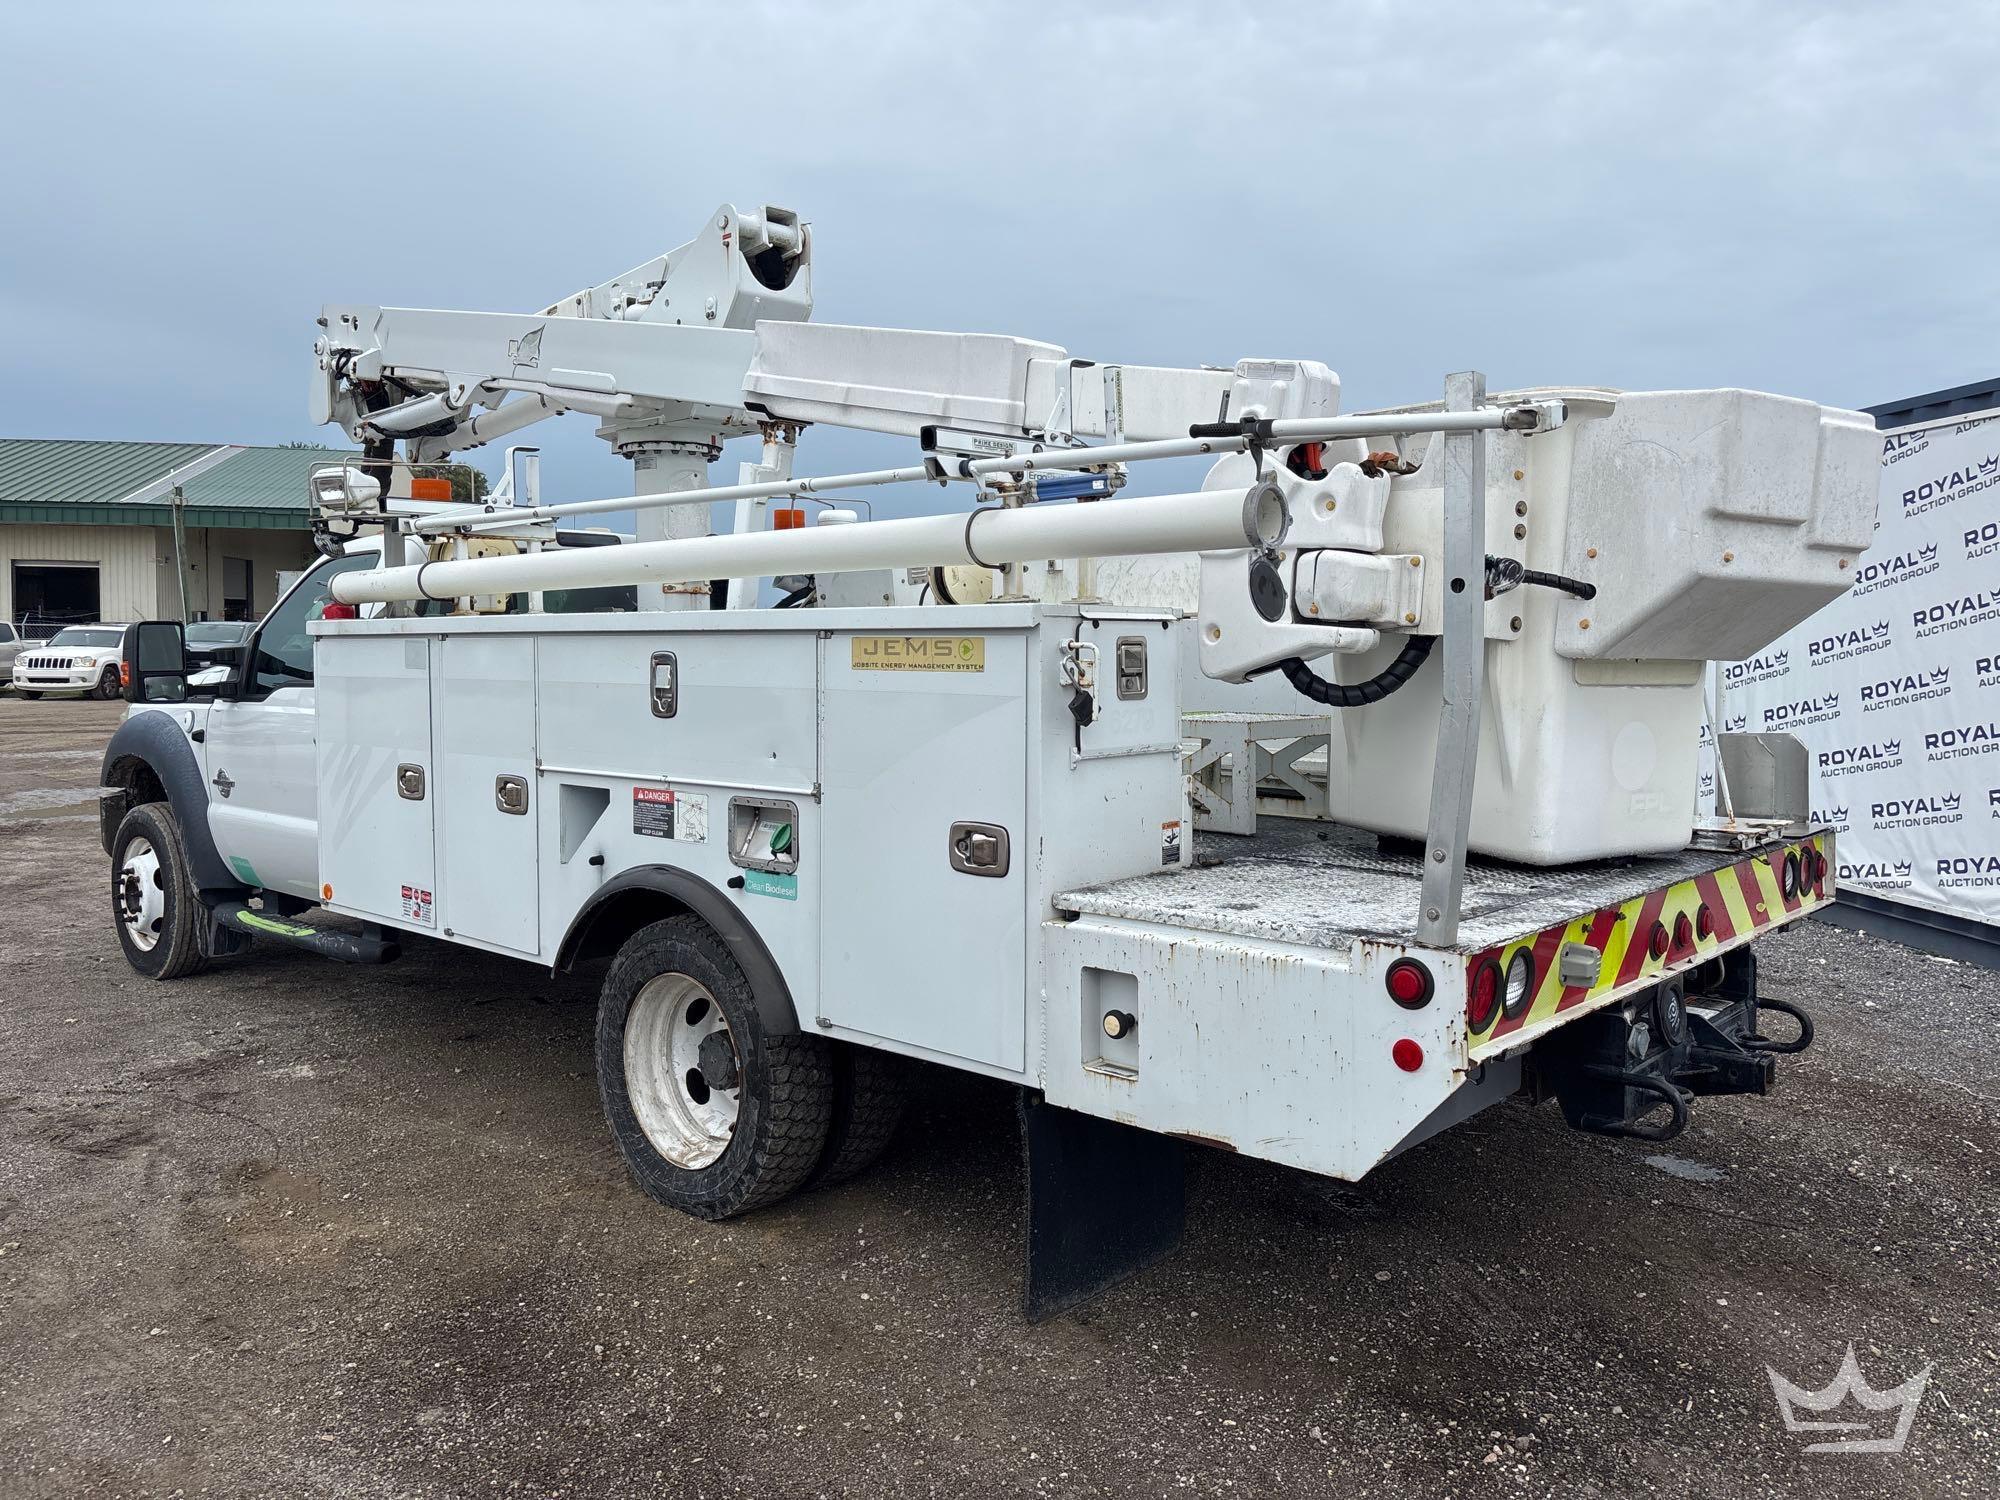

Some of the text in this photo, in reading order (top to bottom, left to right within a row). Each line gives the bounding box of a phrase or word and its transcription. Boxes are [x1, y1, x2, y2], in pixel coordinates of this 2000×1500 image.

[1890, 440, 1929, 464] GROUP
[1902, 466, 1978, 508] ROYAL
[1904, 493, 1955, 519] AUCTION
[1966, 541, 2000, 560] AUCT
[1852, 562, 1940, 598] AUCTION GROUP
[1913, 593, 1990, 628] ROYAL
[1915, 618, 1967, 639] AUCTION
[863, 640, 953, 657] JEMS
[1808, 628, 1872, 657] ROYAL
[1811, 639, 1892, 668] AUCTION GROUP
[1758, 667, 1790, 681] GROUP
[1860, 673, 1931, 702] ROYAL
[1763, 698, 1823, 722] ROYAL
[1863, 686, 1951, 713] AUCTION GROUP
[1765, 710, 1841, 733] AUCTION GROUP
[1818, 745, 1883, 767] ROYAL
[1927, 746, 1980, 762] AUCTION
[1820, 758, 1903, 778] AUCTION GROUP
[644, 791, 670, 802] DANGER
[1871, 797, 1942, 818] ROYAL
[1873, 813, 1963, 830] AUCTION GROUP
[1838, 863, 1891, 879] OYAL
[1937, 856, 2000, 875] ROYA
[746, 880, 796, 897] Clean Biodiesel
[1938, 876, 1994, 888] AUCTION
